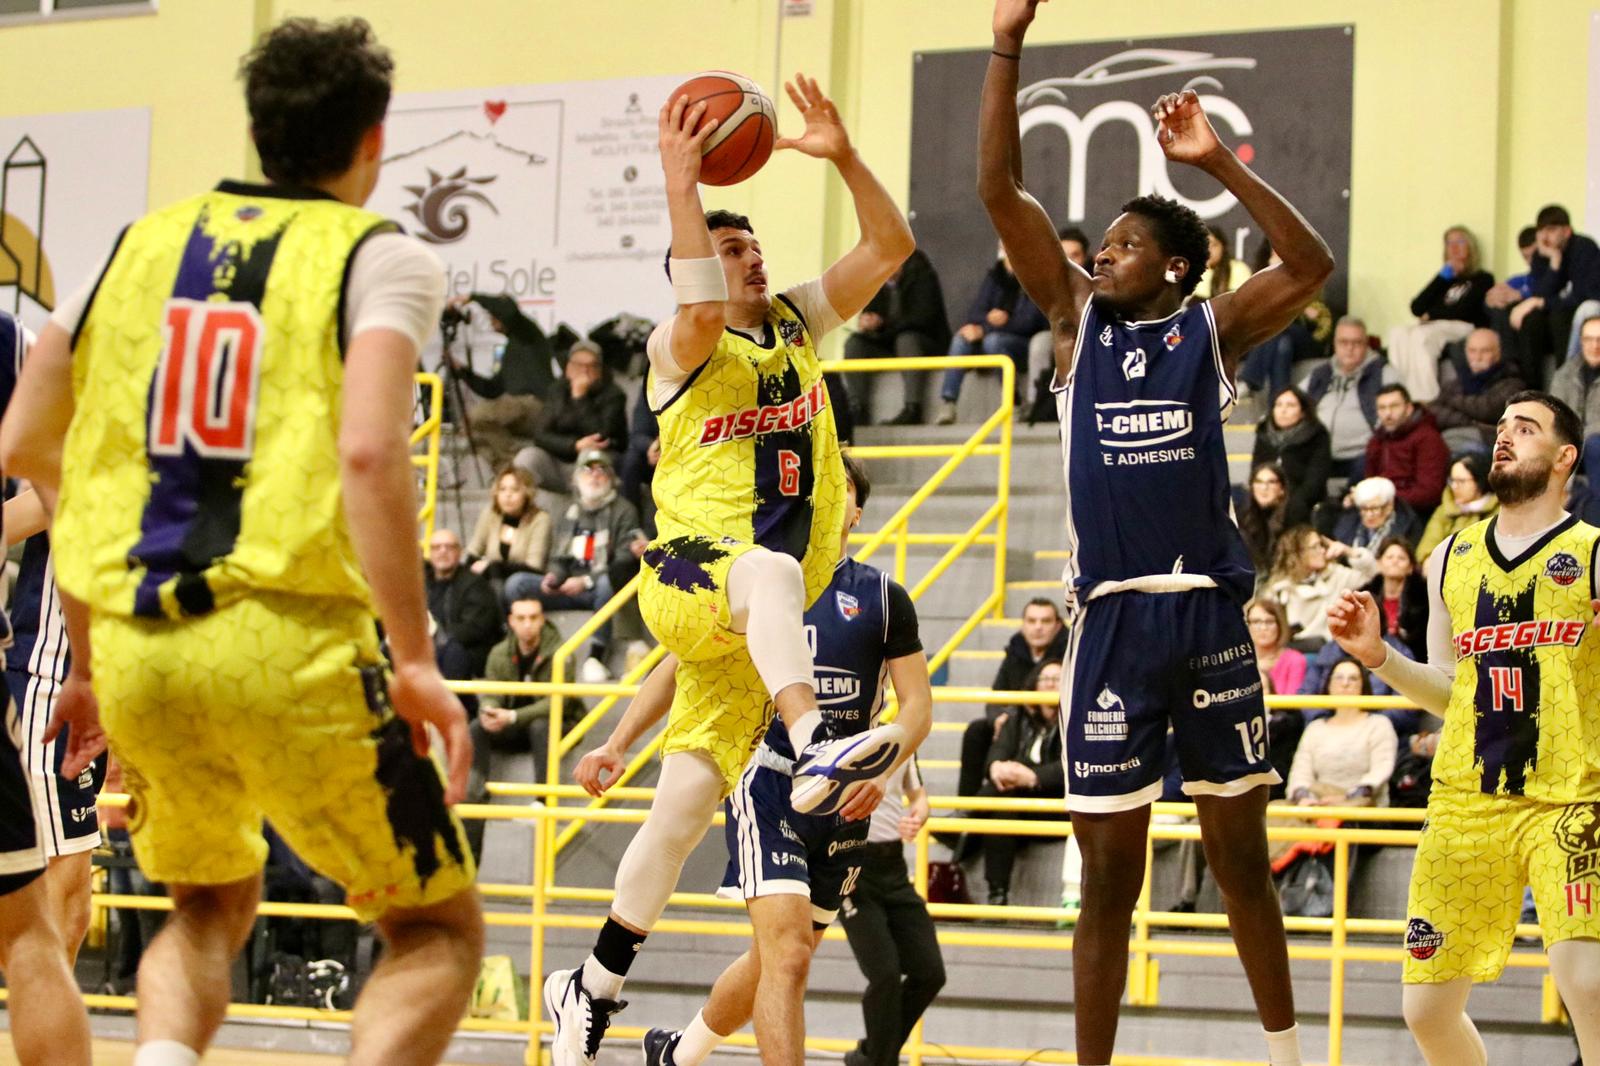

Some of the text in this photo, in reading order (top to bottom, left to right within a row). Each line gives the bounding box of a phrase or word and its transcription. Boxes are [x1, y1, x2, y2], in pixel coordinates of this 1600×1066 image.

[490, 257, 557, 296] Sole
[150, 298, 265, 459] 10
[778, 450, 801, 496] 6
[1117, 447, 1196, 466] ADHESIVES
[1489, 666, 1524, 712] 14
[1234, 715, 1265, 765] 12
[1089, 756, 1142, 774] moretti
[1564, 882, 1591, 917] 14
